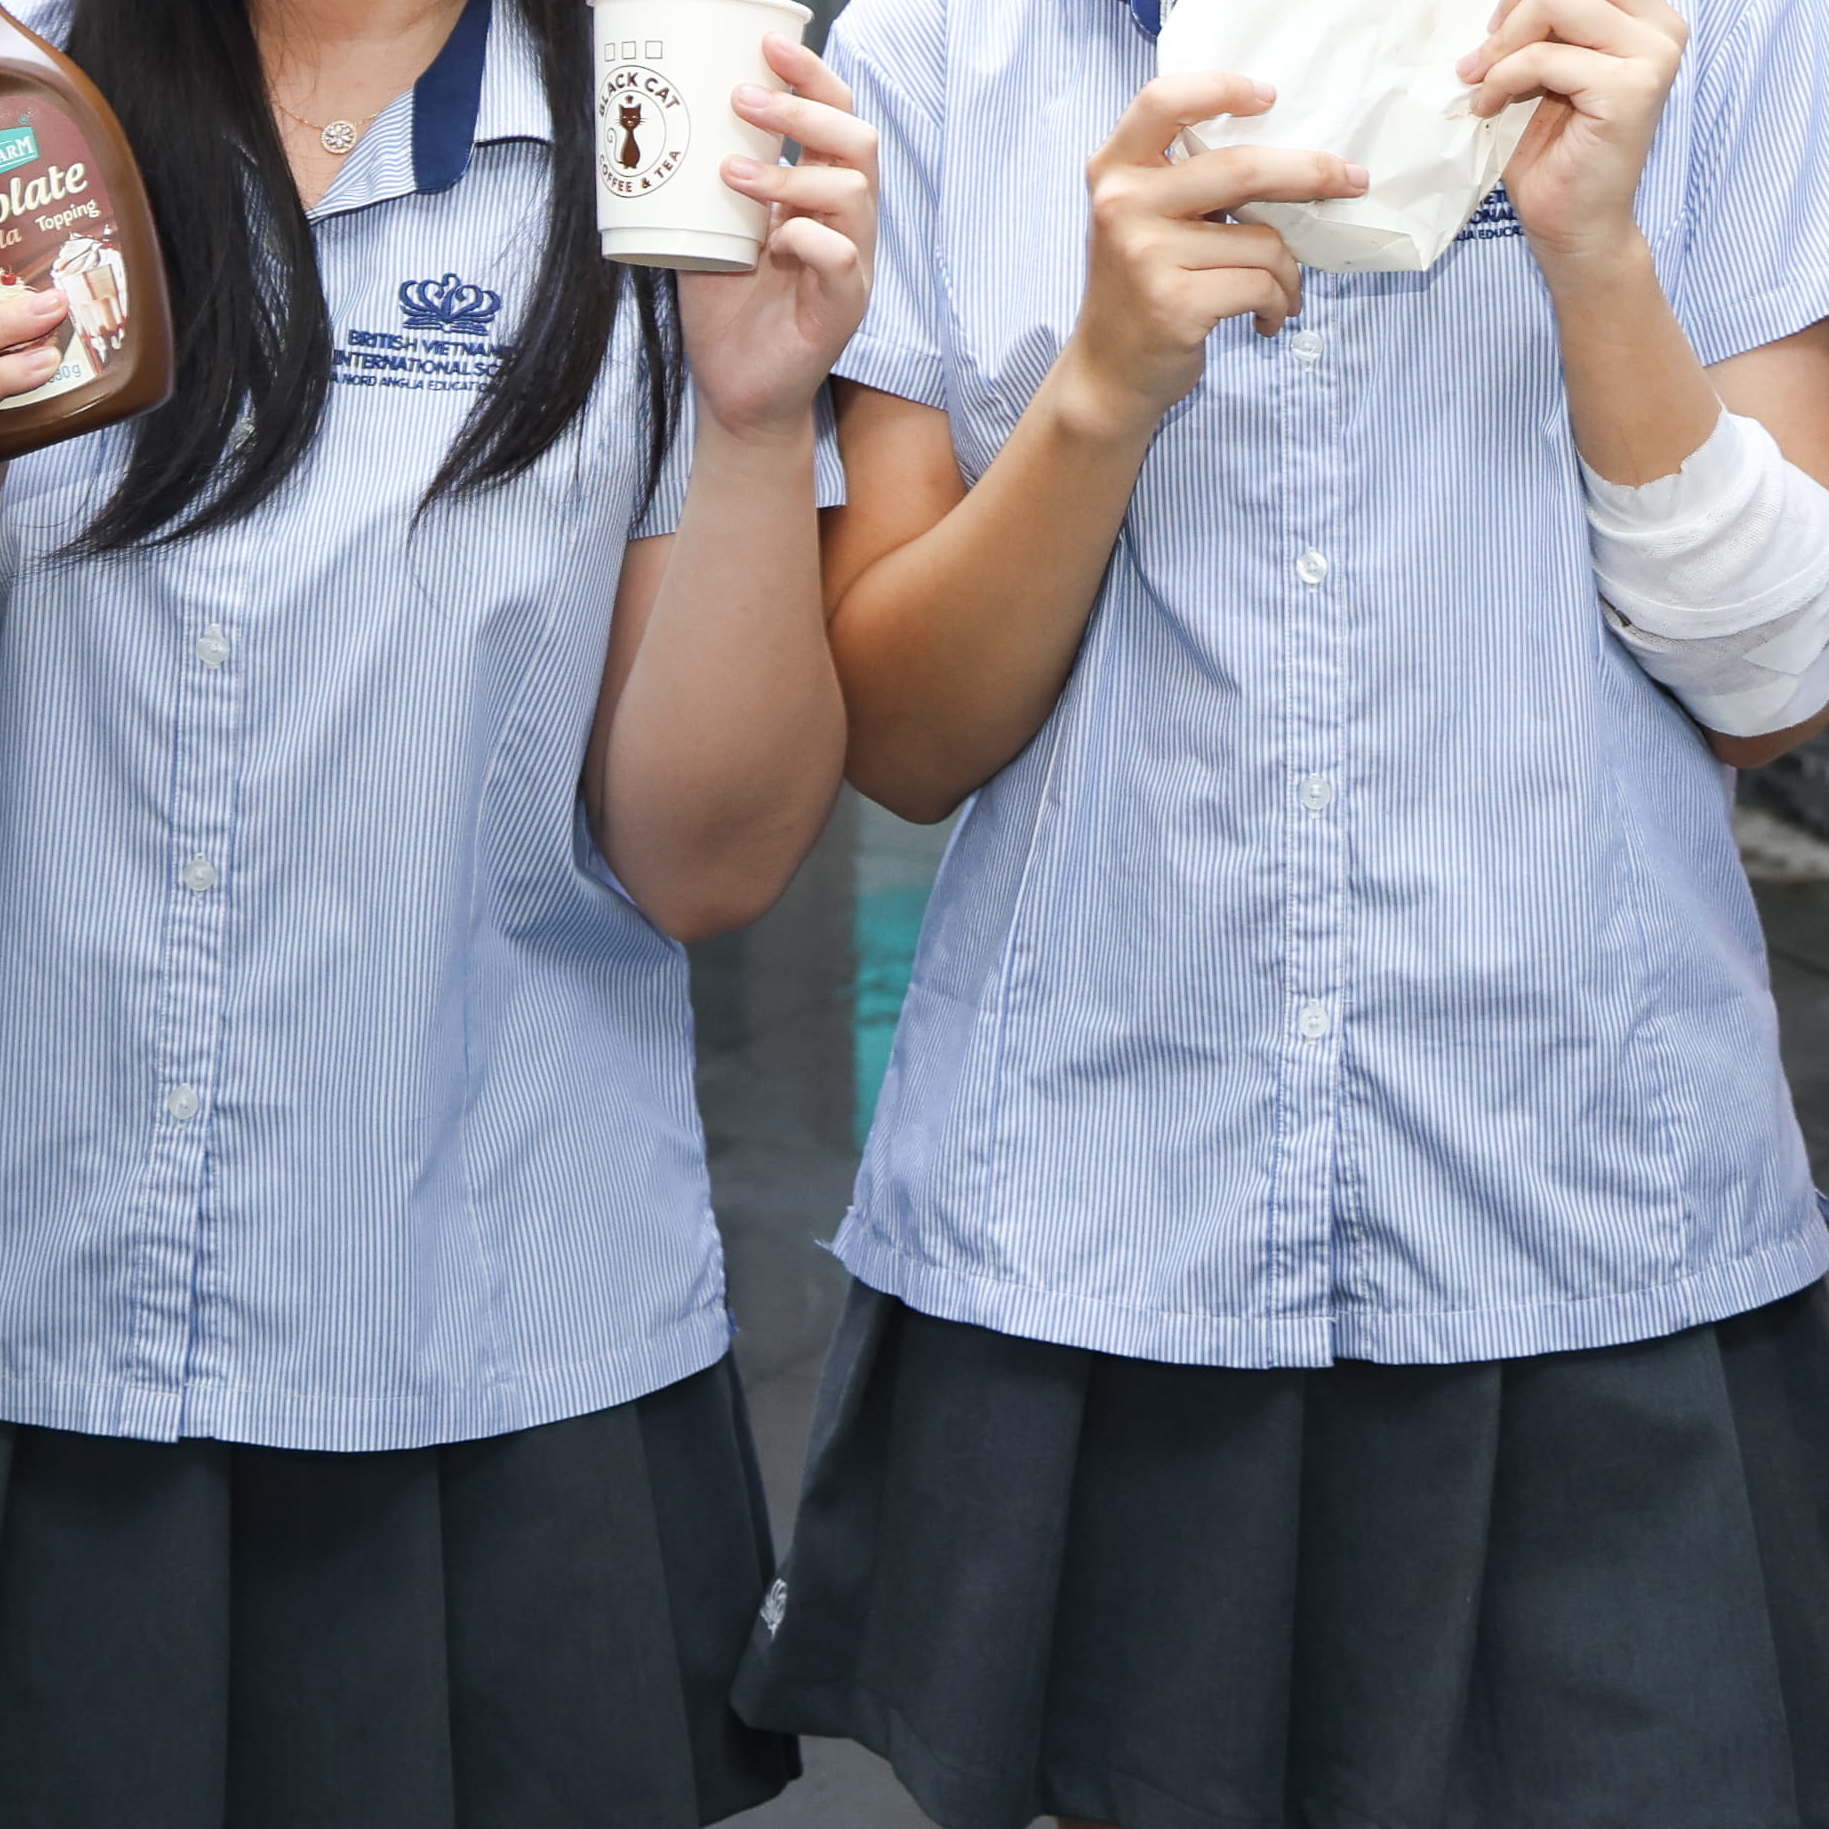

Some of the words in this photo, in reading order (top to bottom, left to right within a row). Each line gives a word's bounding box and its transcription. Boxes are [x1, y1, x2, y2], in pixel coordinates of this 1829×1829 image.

[599, 72, 639, 117] BLACK
[645, 77, 681, 109] CAT
[599, 154, 632, 193] COFFEE
[641, 177, 651, 189] &
[654, 151, 681, 178] TEA
[35, 199, 100, 232] Topping
[1478, 225, 1524, 240] EDUCA
[348, 329, 417, 353] BRITISH
[333, 350, 467, 376] INTERNATIONAL
[342, 374, 377, 387] NORD
[379, 376, 423, 391] ANGLIA
[427, 379, 487, 393] EDUCATIO
